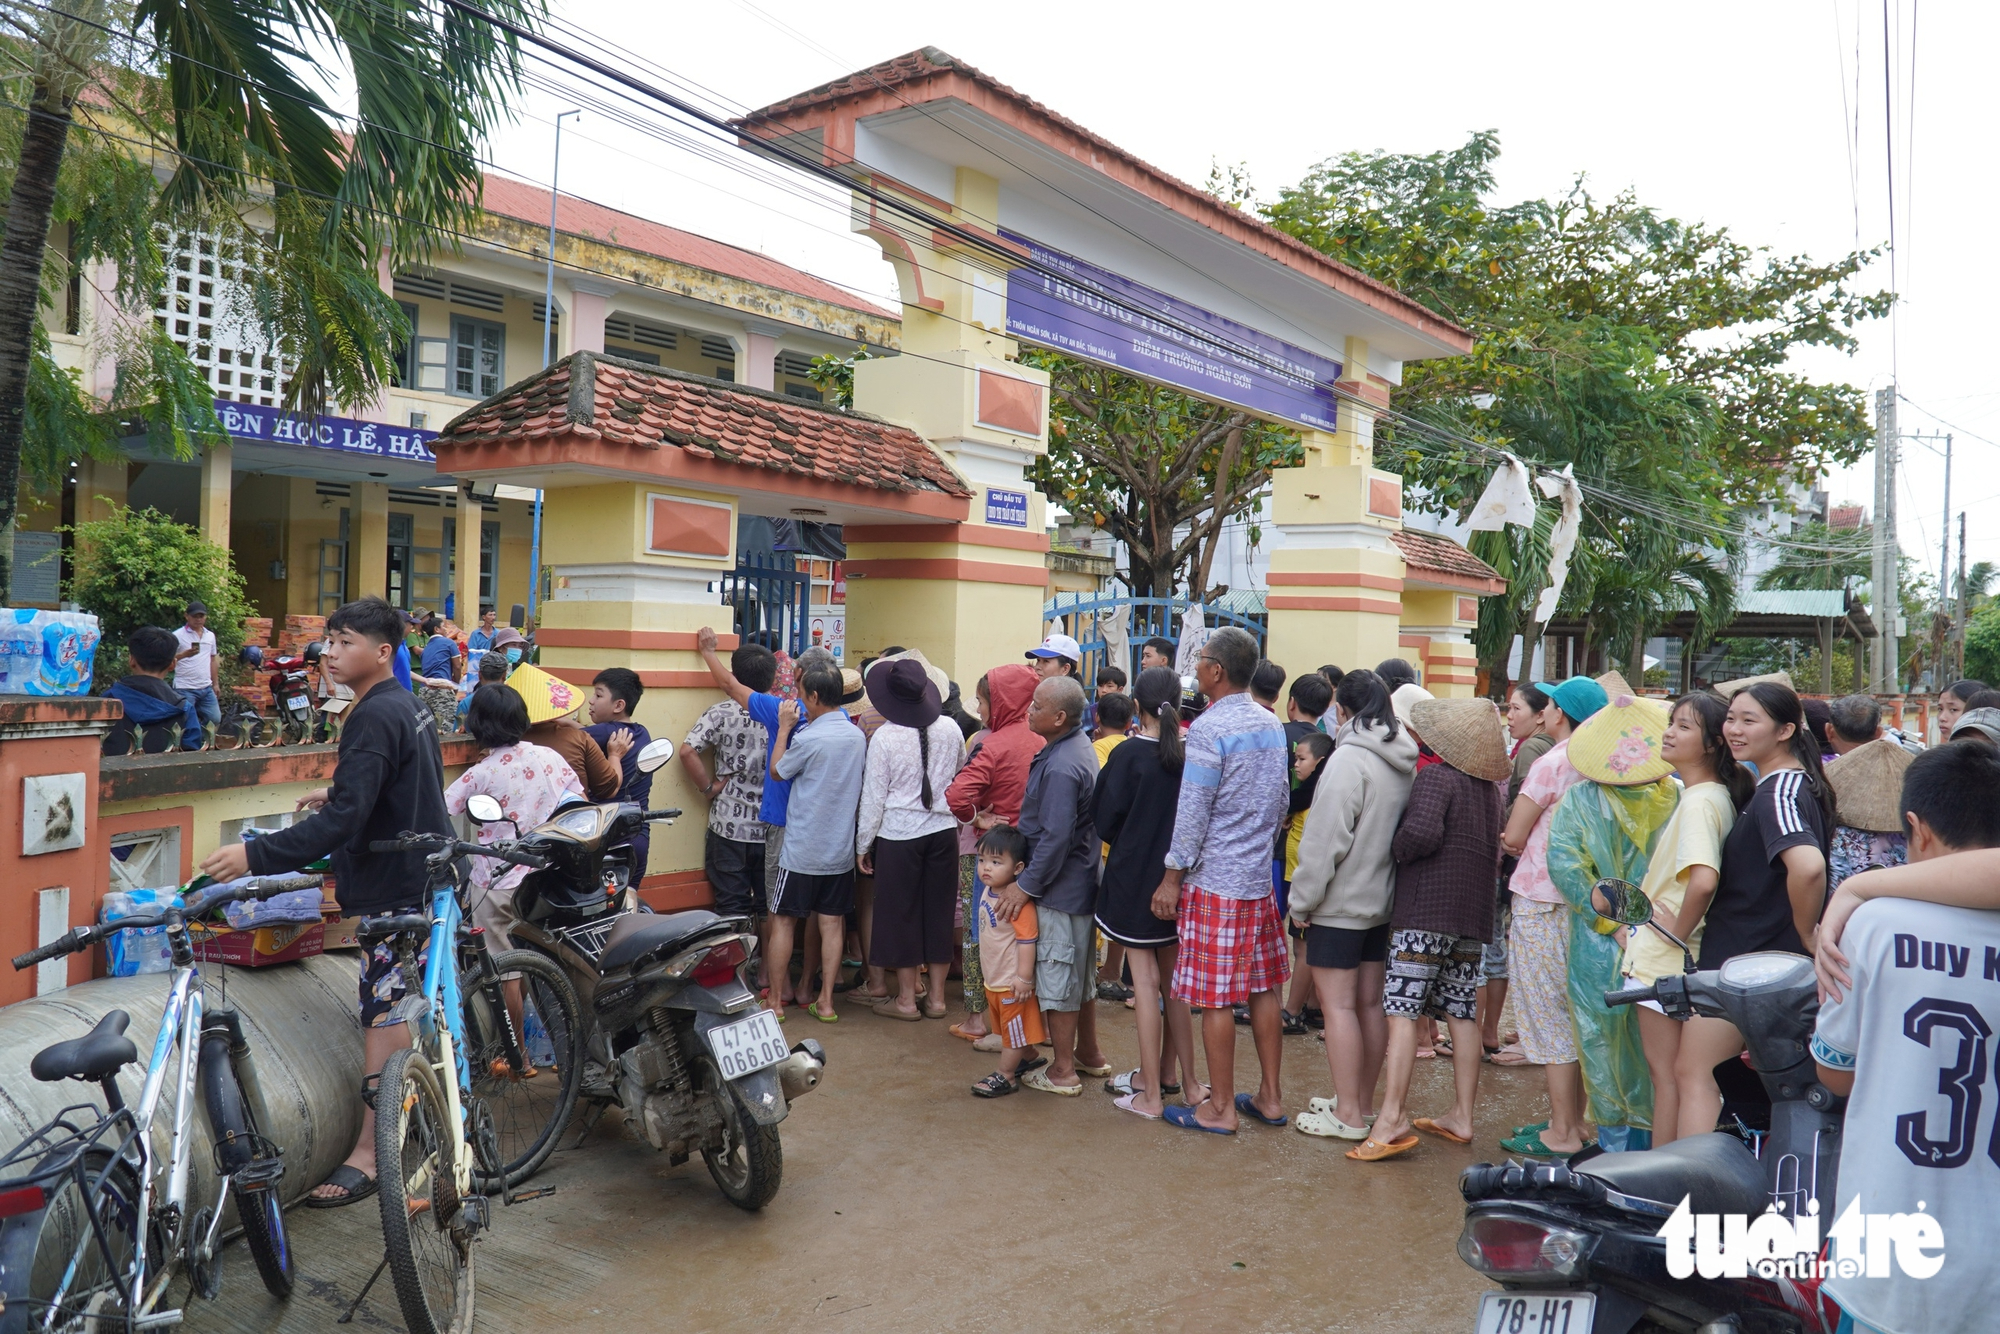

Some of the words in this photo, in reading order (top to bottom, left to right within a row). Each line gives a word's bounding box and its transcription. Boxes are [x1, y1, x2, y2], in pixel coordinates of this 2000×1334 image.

[1012, 320, 1026, 332] THÔN
[1026, 323, 1040, 336] NGÂN
[1052, 330, 1059, 341] XÃ
[1059, 334, 1068, 345] TUY
[1069, 337, 1076, 347] AN
[1132, 335, 1161, 360] ĐIỂM
[1163, 351, 1204, 374] TRƯỜNG
[1206, 362, 1233, 384] NGÂN
[1233, 371, 1252, 390] SƠN
[273, 417, 334, 446] HỌC
[343, 424, 383, 454] LỄ,
[992, 492, 1003, 501] CHỦ
[1004, 493, 1014, 503] ĐẦU
[1015, 496, 1023, 504] TƯ
[1894, 933, 1971, 978] Duy
[503, 1008, 518, 1048] MUYMA
[720, 1016, 770, 1049] 47-M1
[186, 1014, 202, 1096] ASAMA
[722, 1038, 786, 1077] 066.06
[1495, 1299, 1574, 1334] 78-H1
